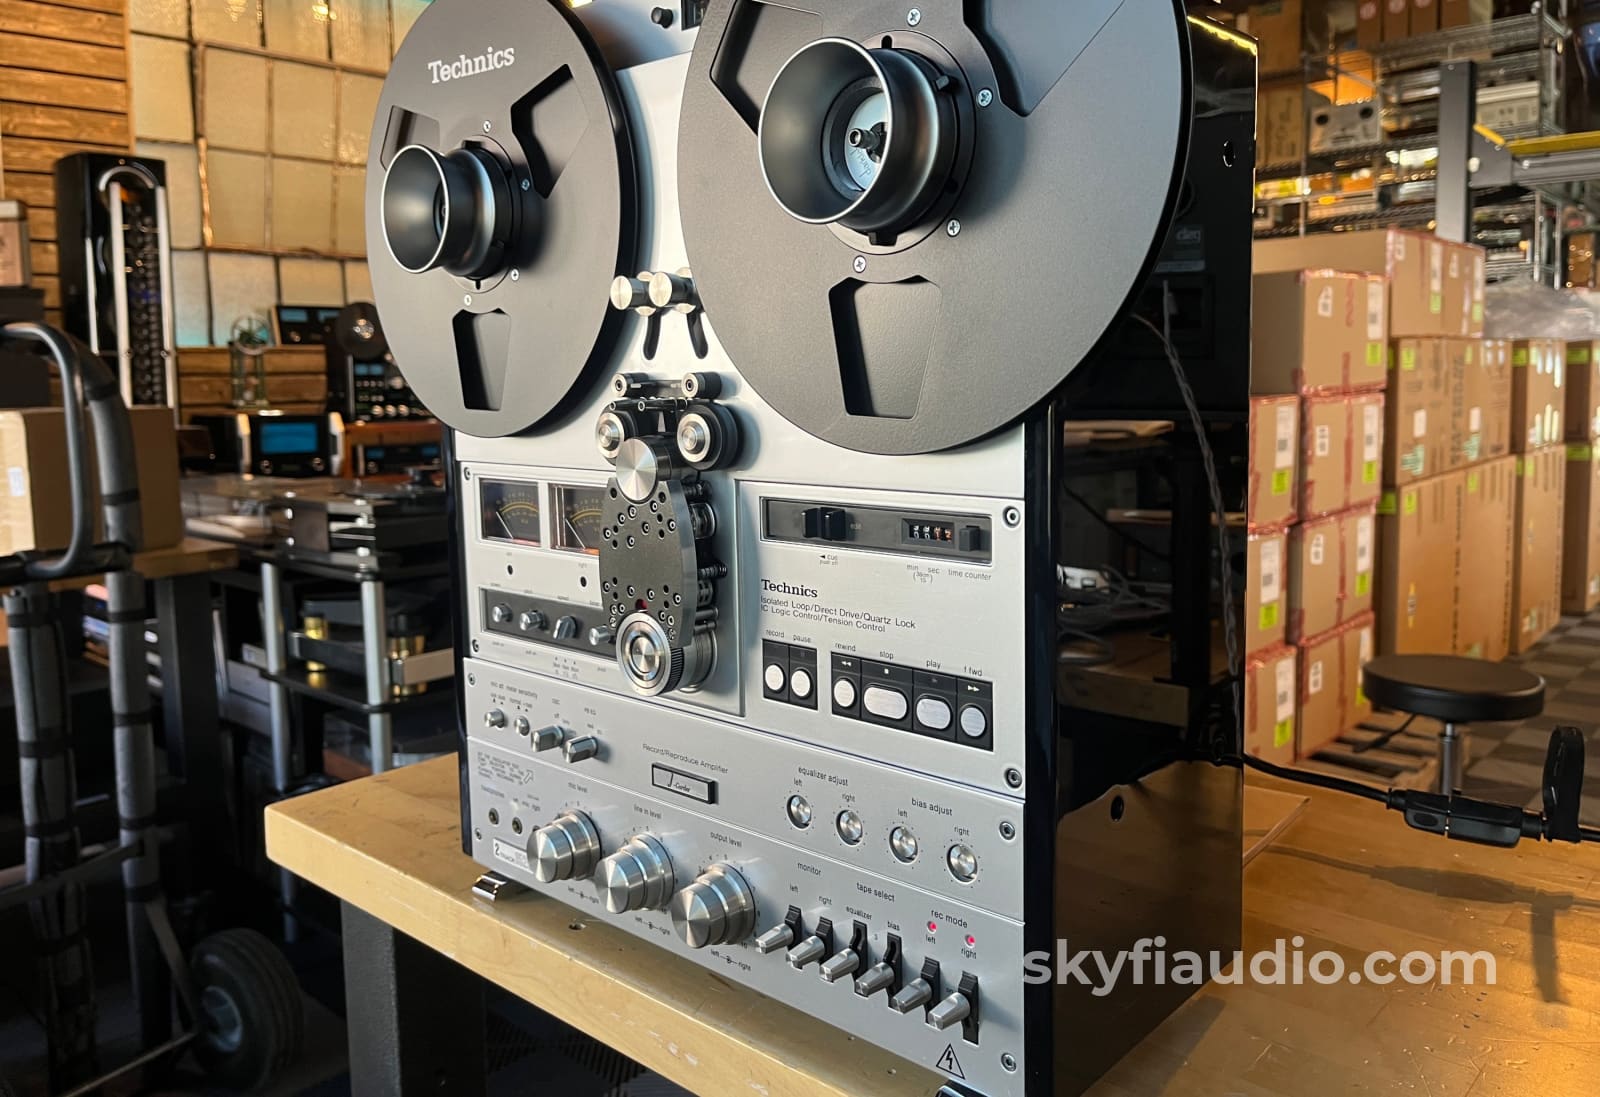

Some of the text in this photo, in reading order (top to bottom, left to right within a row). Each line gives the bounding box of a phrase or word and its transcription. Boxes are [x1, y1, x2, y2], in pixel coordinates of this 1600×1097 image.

[427, 46, 515, 84] Technics
[948, 569, 963, 578] time
[964, 571, 992, 581] counter
[760, 578, 818, 598] Technics
[760, 596, 917, 629] Isolated Loop/Direct Drive/Quartz Lock
[772, 606, 790, 617] Logic
[792, 610, 853, 627] Control/Tension
[856, 622, 886, 632] Control
[766, 628, 812, 644] record pause
[834, 642, 856, 652] rewind
[879, 650, 894, 660] stop
[926, 660, 941, 669] play
[642, 744, 728, 774] Record/Reproduce Amplifier
[794, 778, 802, 787] left
[798, 766, 848, 786] equalizer adjust
[842, 793, 856, 803] right
[898, 808, 908, 818] left
[912, 798, 953, 816] bias adjust
[649, 810, 662, 820] level
[954, 826, 970, 837] right
[710, 831, 742, 848] output level
[797, 862, 822, 876] monitor
[790, 884, 799, 893] left
[856, 882, 896, 902] tape select
[818, 895, 832, 906] right
[846, 906, 872, 920] equalizer
[930, 910, 968, 929] rec mode
[887, 920, 900, 931] bias
[926, 935, 936, 945] left
[710, 949, 752, 972] left right
[960, 948, 977, 960] right
